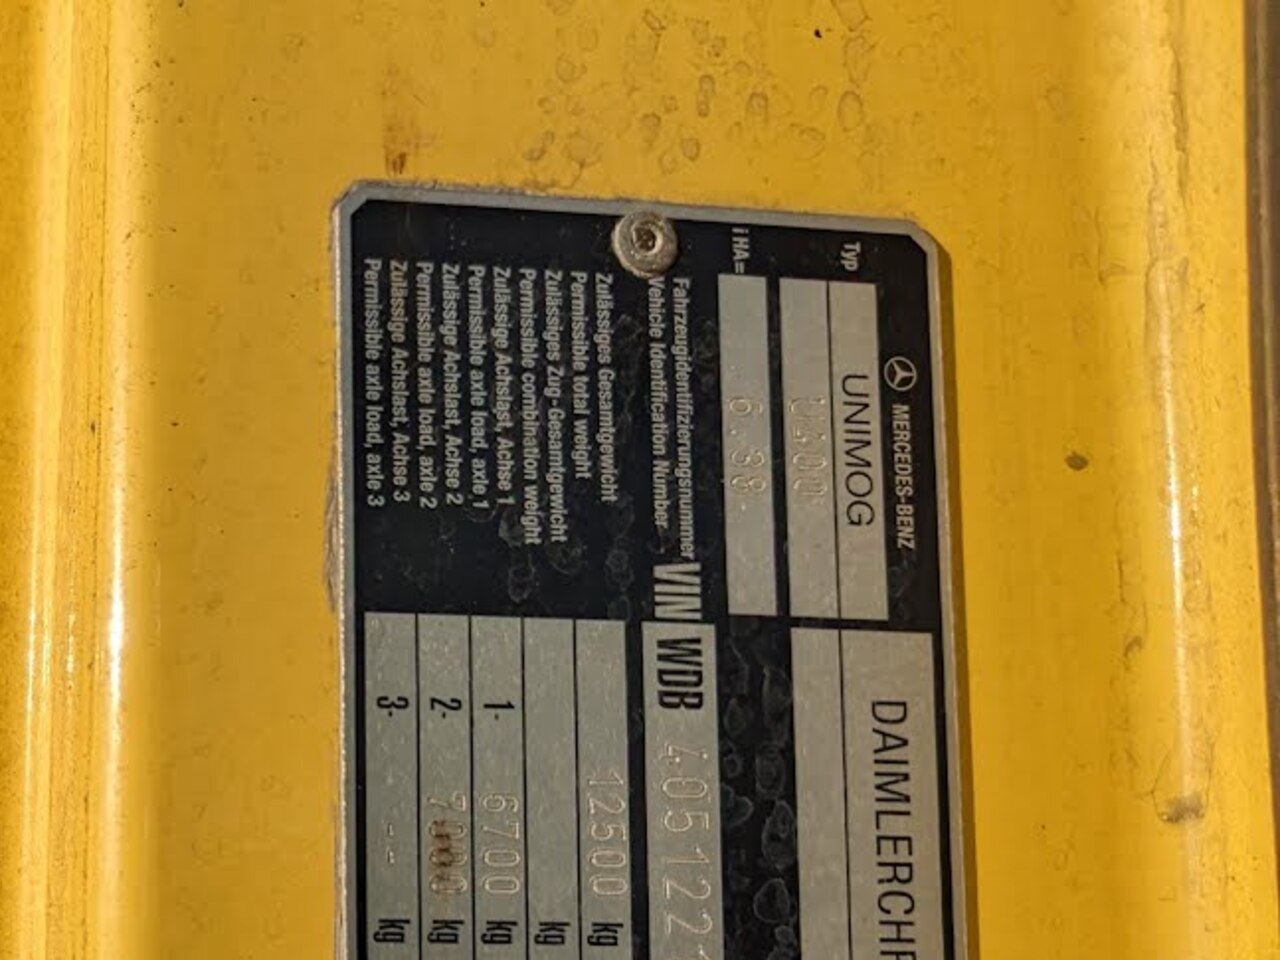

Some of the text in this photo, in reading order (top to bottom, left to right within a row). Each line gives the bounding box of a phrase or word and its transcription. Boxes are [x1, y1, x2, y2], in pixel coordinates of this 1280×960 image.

[841, 241, 861, 271] Typ
[362, 258, 385, 507] Permissible axle load, axle 3
[387, 260, 411, 502] Zulässige Achslast, Achse 3
[415, 261, 438, 509] Permissible axle load, axle 2
[439, 262, 463, 505] Zulässige Achslast, Achse 2
[467, 265, 489, 508] Permissible axle load, axle 1
[491, 266, 515, 505] Zulässige Achslast, Achse 1
[519, 268, 543, 545] Permissible combination weight
[543, 269, 568, 542] Zulässiges Zug-Gesamtgewicht
[569, 271, 592, 479] Permissible total weight
[592, 273, 618, 502] Zulässiges Gesamtgewicht
[647, 277, 670, 528] Vehicle Identification Number
[670, 277, 695, 560] Fahrzeugidentifizierungsnummer
[842, 373, 875, 526] UNIMOG
[892, 404, 915, 549] MERCEDES-BENZ
[652, 562, 702, 620] VIN
[656, 637, 704, 710] WDB
[425, 791, 468, 895] 7000
[479, 791, 521, 895] 6700
[587, 770, 628, 896] 12500
[373, 918, 411, 944] kg
[427, 919, 464, 945] kg
[481, 920, 518, 945] kg
[535, 921, 570, 945] kg
[587, 922, 624, 947] kg
